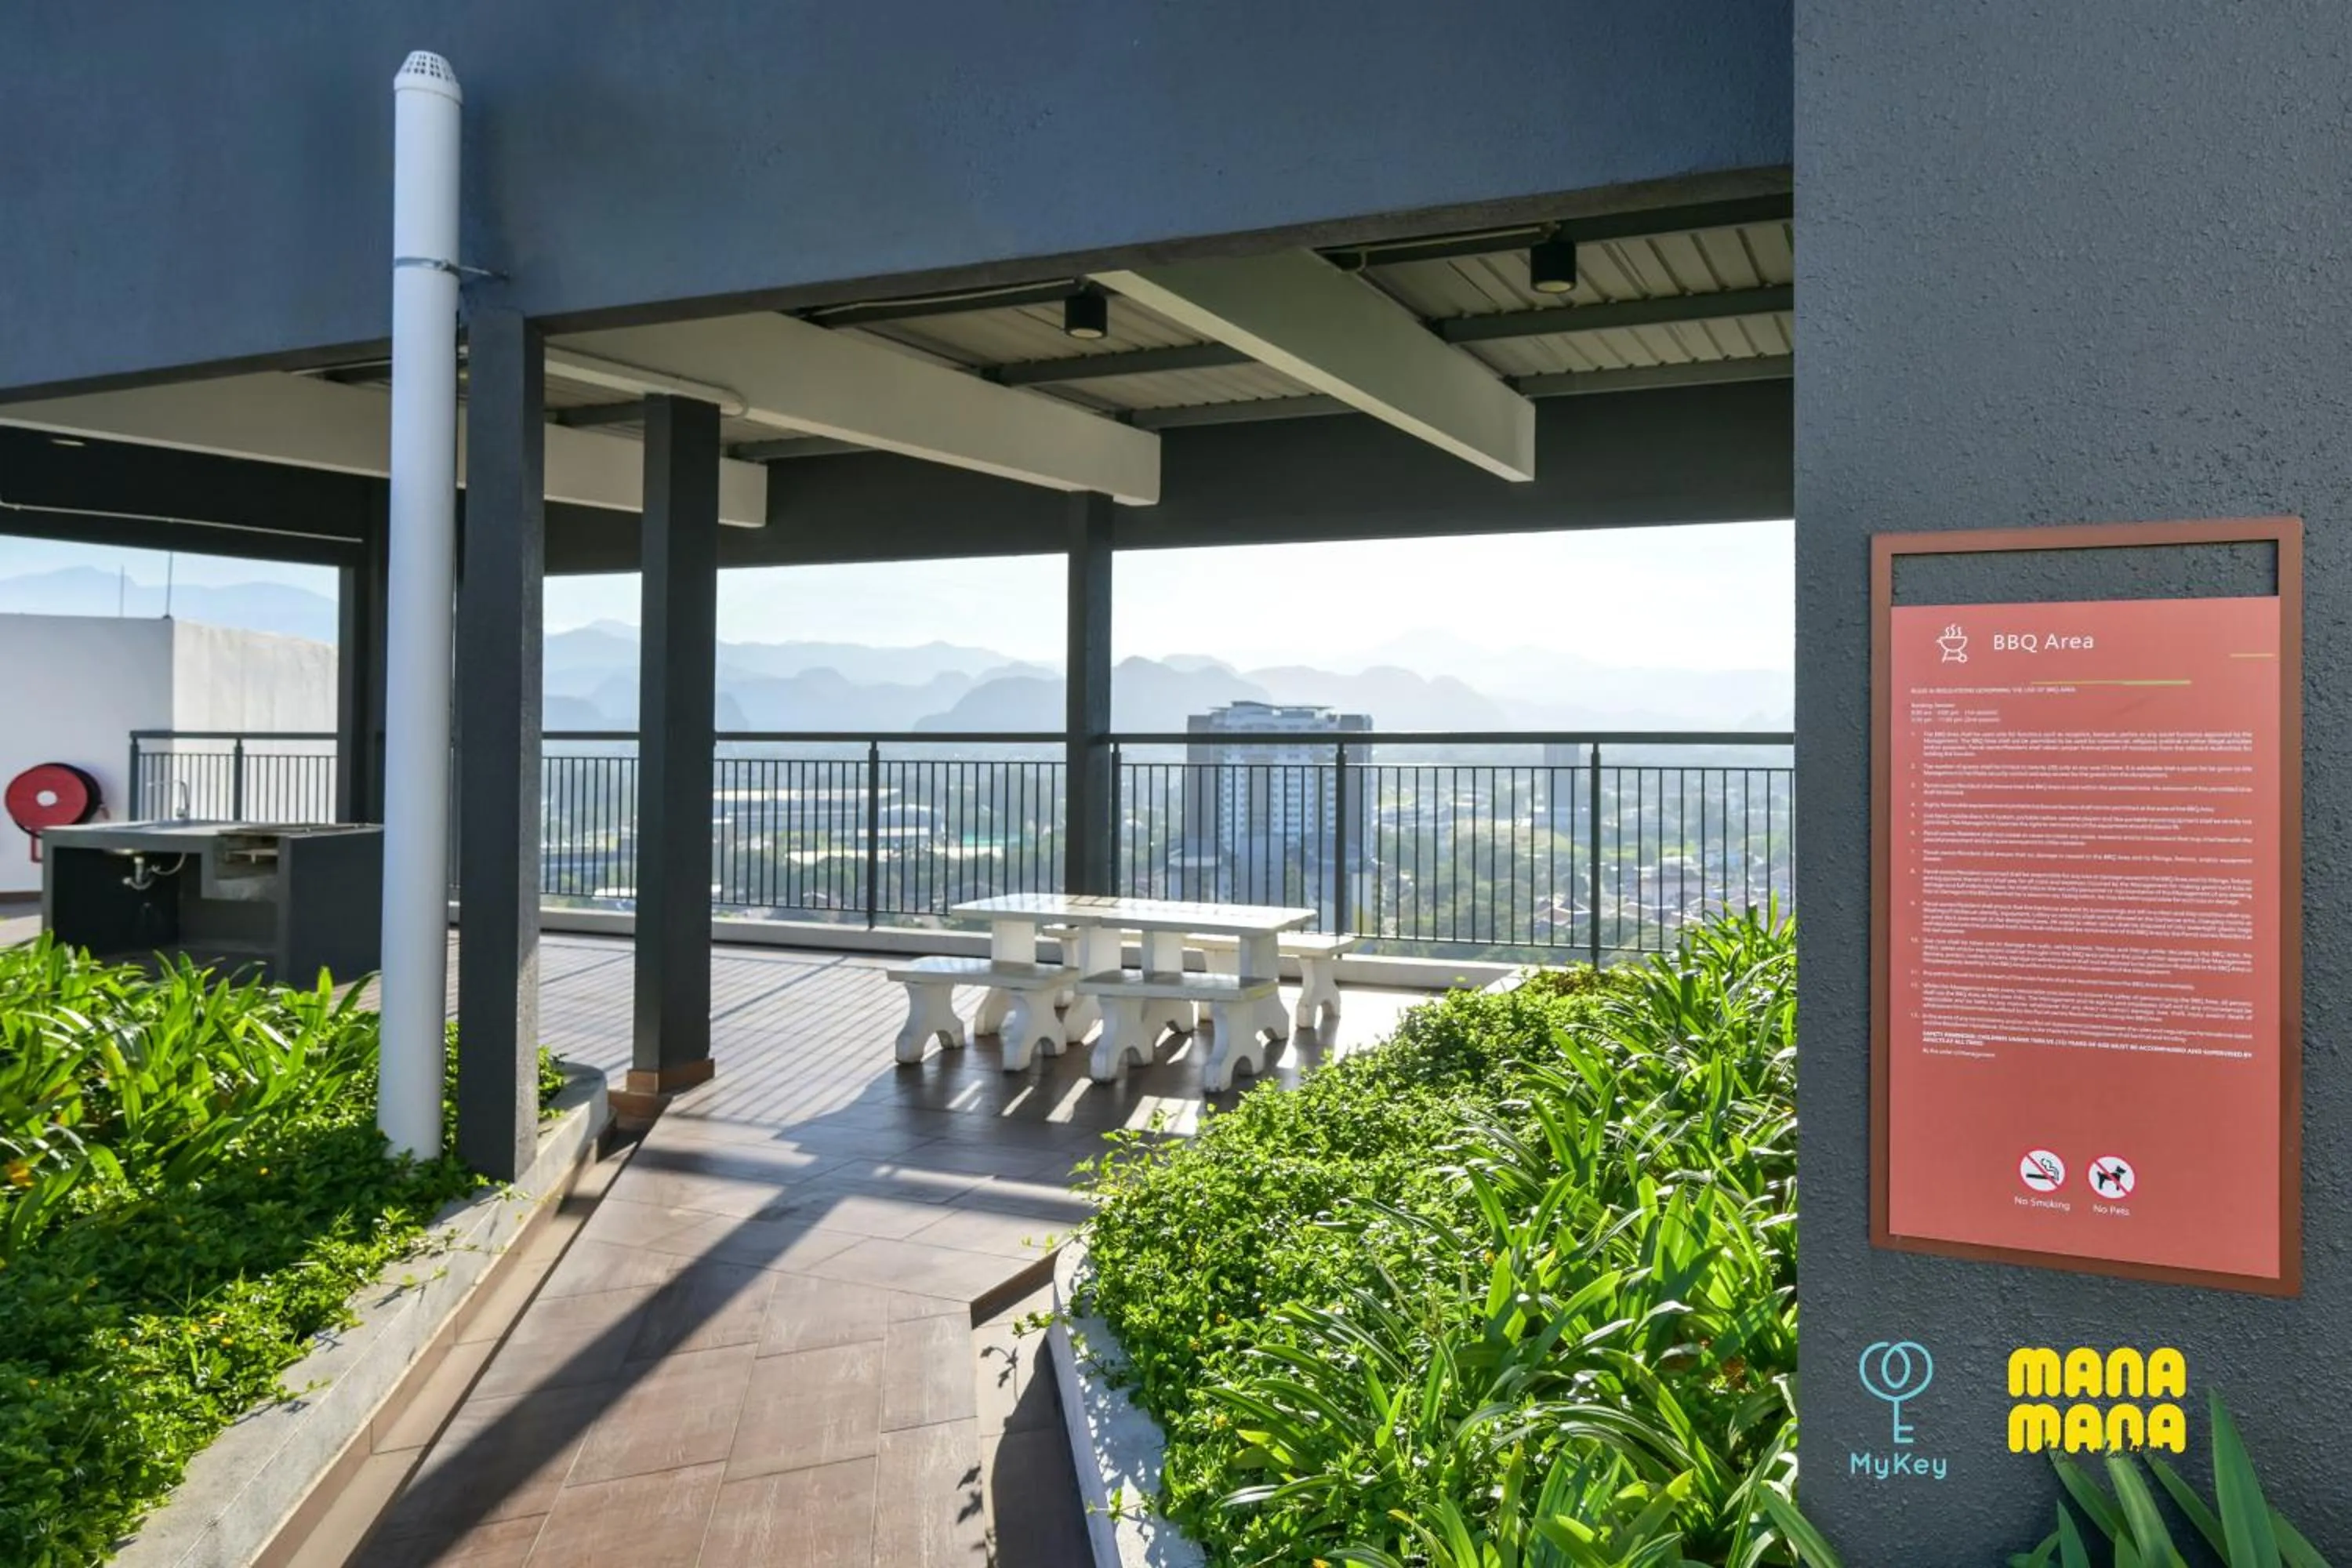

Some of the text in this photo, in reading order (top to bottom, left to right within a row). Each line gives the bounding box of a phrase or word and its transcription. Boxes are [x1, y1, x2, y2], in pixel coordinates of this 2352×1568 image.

[1994, 633, 2095, 653] BBQ Area
[2014, 1196, 2071, 1211] No Smoking
[2092, 1203, 2130, 1216] No Pets
